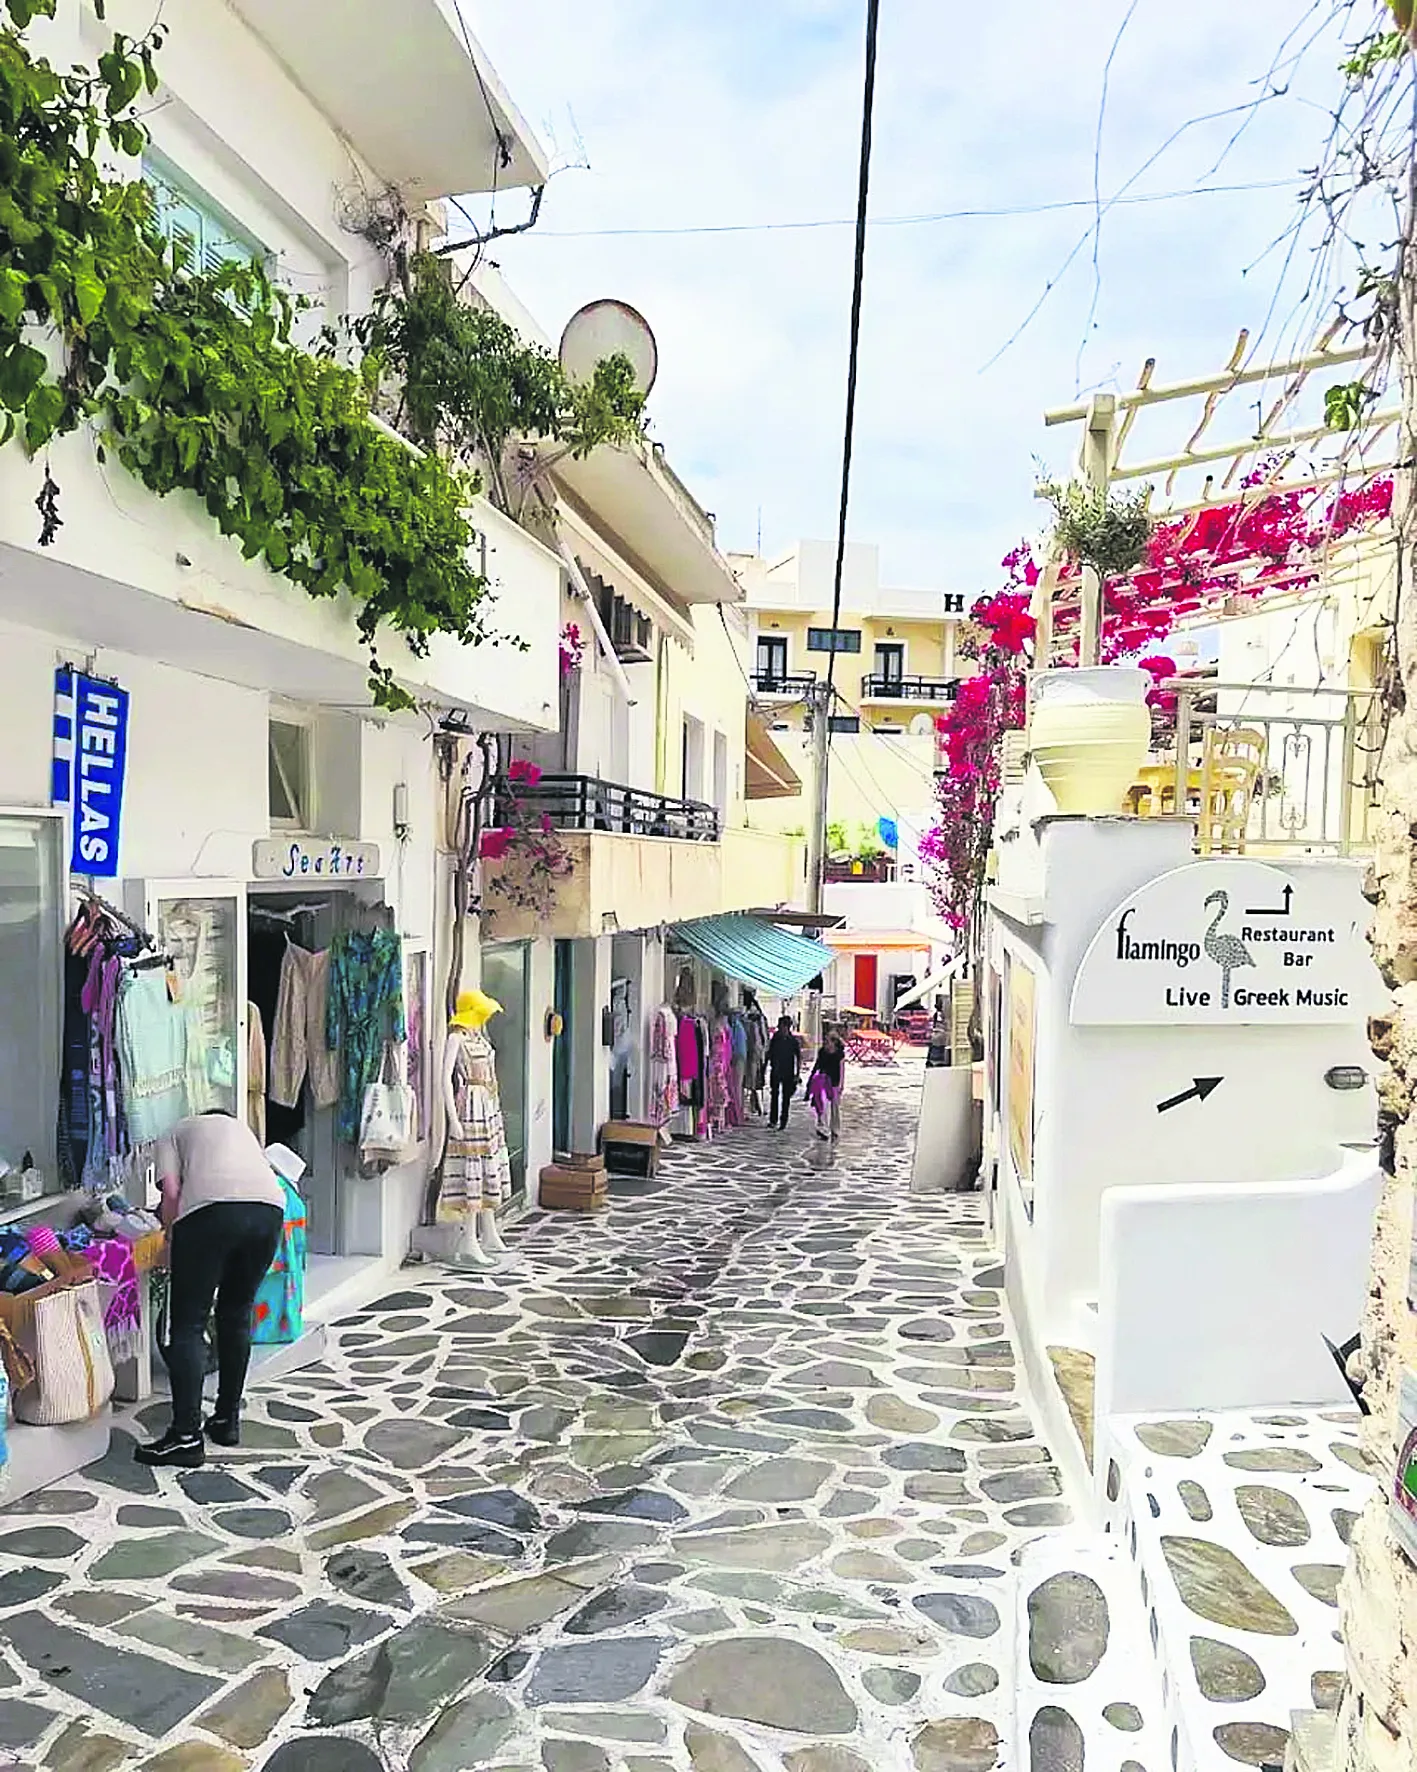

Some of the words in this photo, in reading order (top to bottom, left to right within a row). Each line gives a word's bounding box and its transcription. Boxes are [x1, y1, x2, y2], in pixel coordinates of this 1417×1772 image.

[80, 692, 119, 863] HELLAS
[1116, 908, 1200, 967] flamingo
[1242, 926, 1335, 943] Restaurant
[1283, 951, 1313, 967] Bar
[1166, 987, 1211, 1007] Live
[1234, 988, 1289, 1007] Greek
[1296, 988, 1348, 1007] Music
